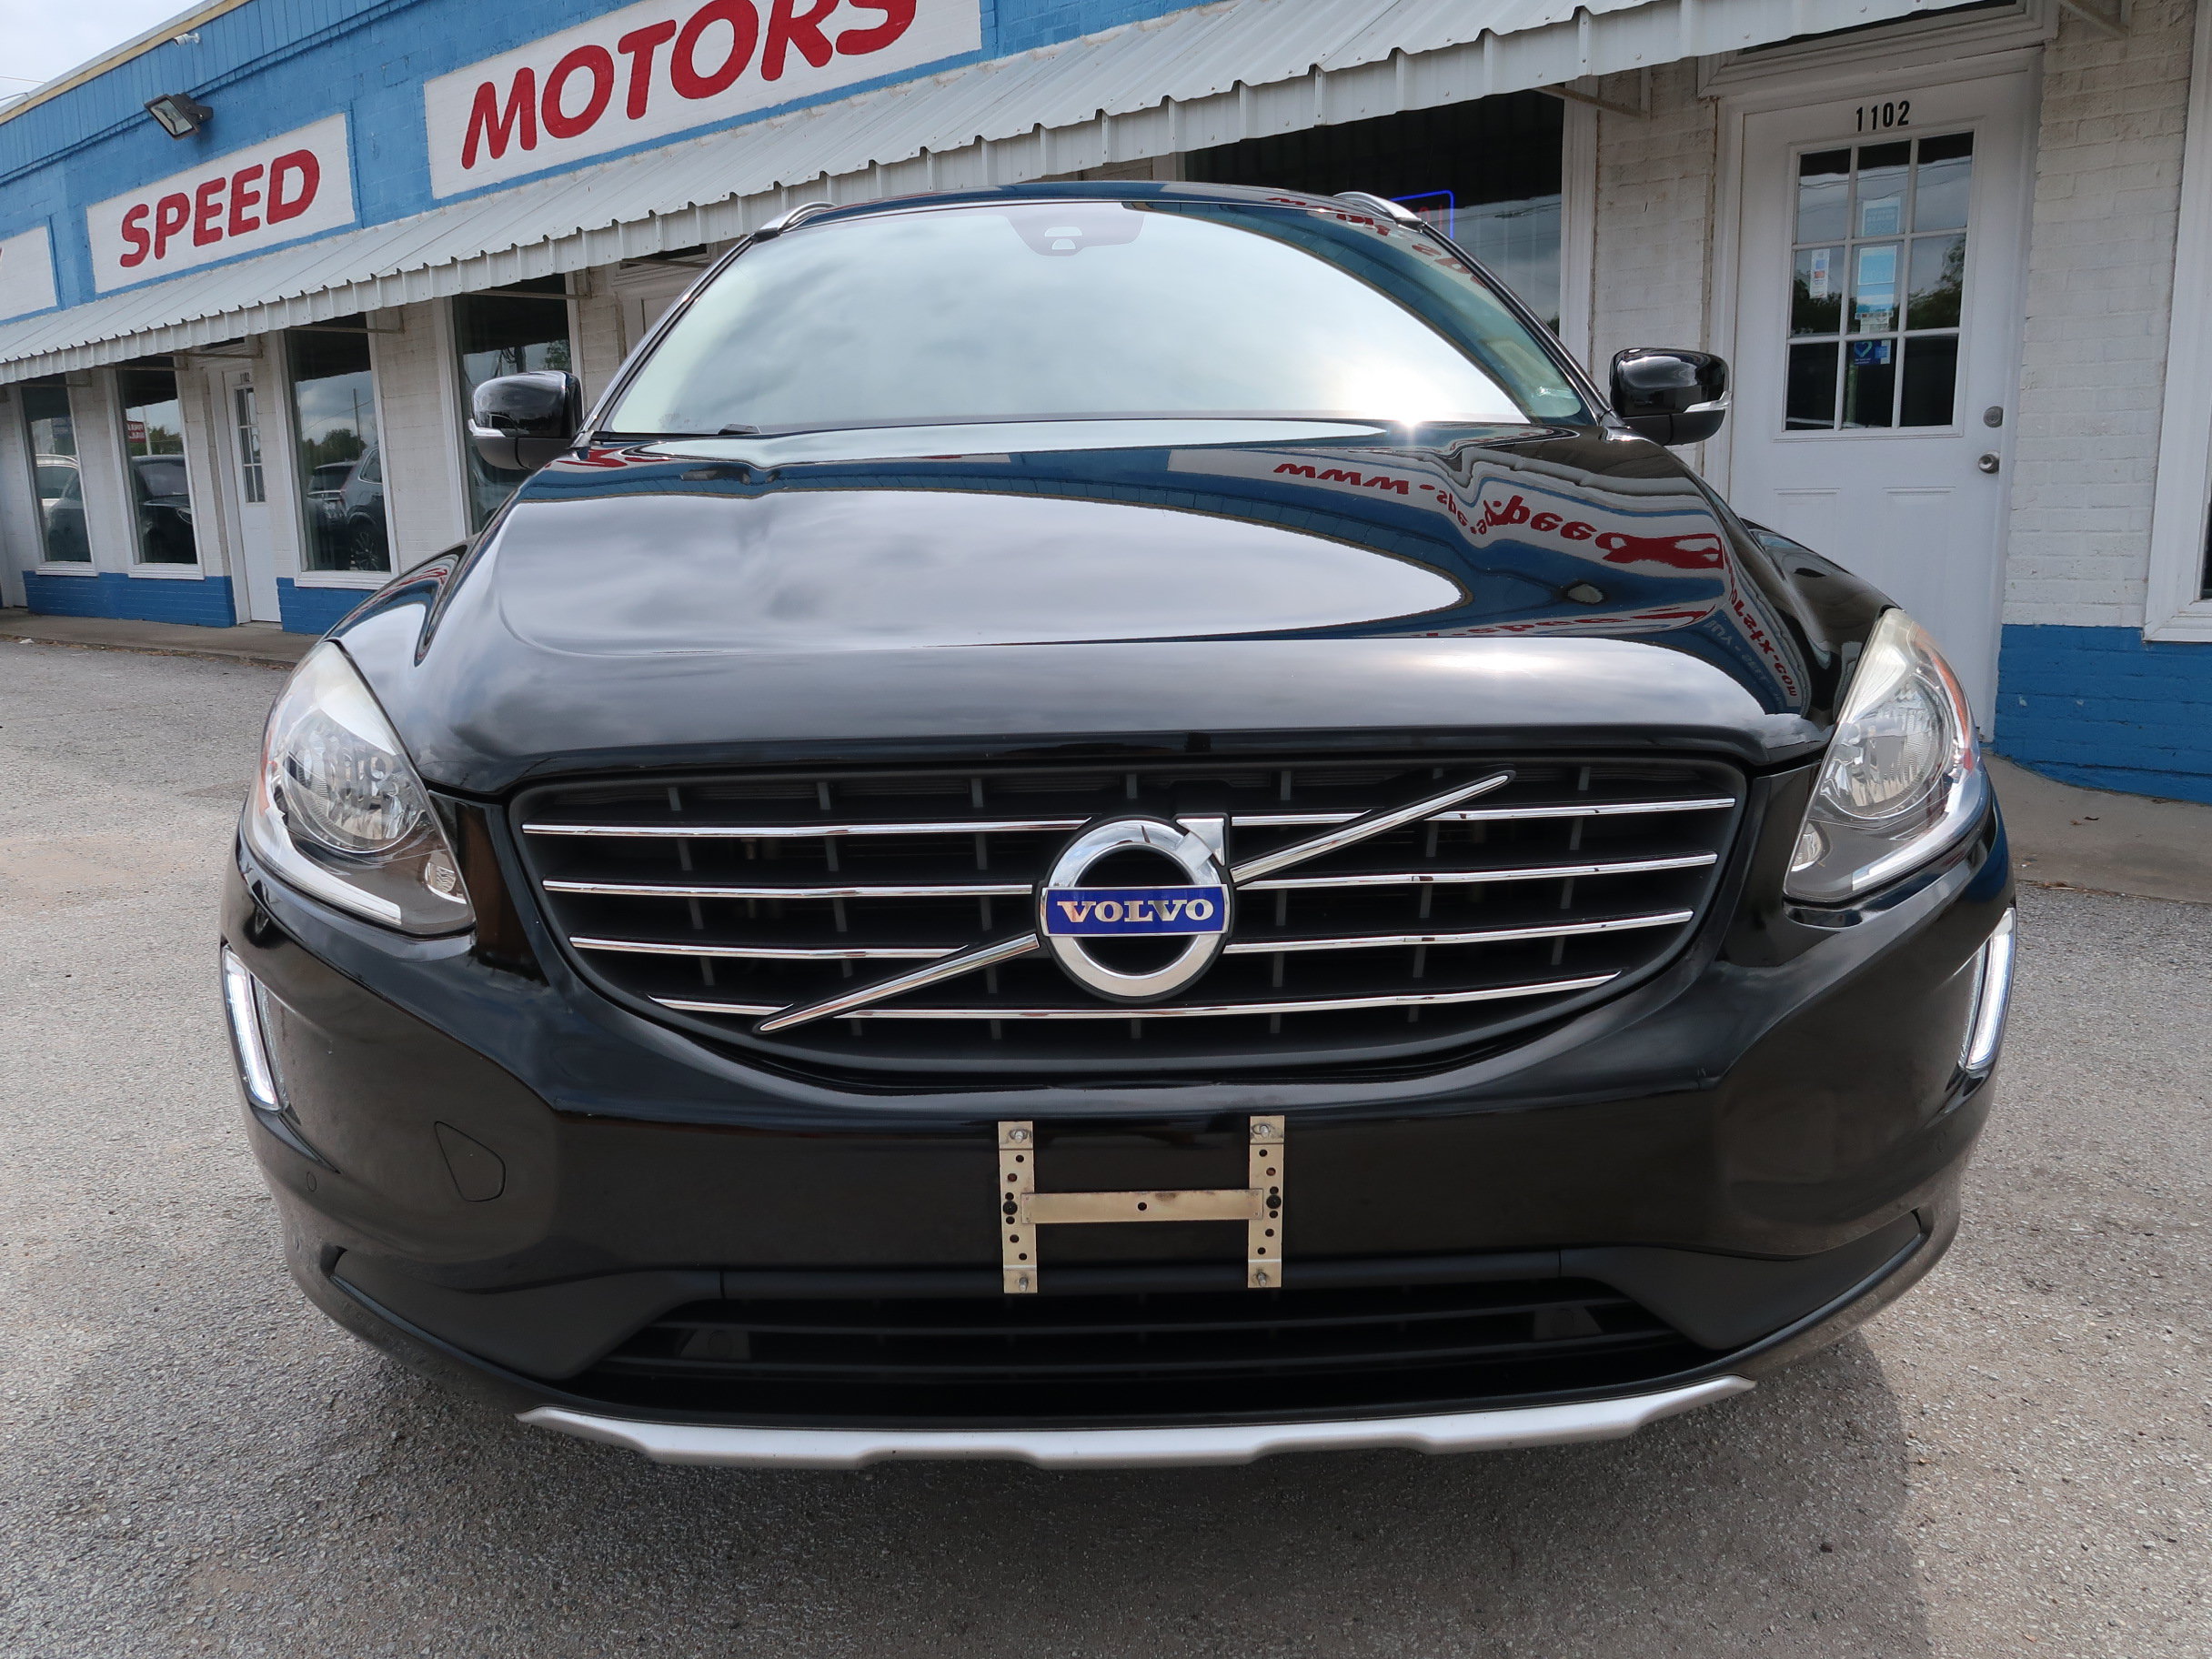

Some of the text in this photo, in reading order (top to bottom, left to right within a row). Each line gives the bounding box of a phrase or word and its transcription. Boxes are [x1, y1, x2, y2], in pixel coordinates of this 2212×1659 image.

[1855, 100, 1912, 132] 1102
[119, 0, 917, 268] SPEED MOTORS
[1057, 899, 1214, 923] VOLVO
